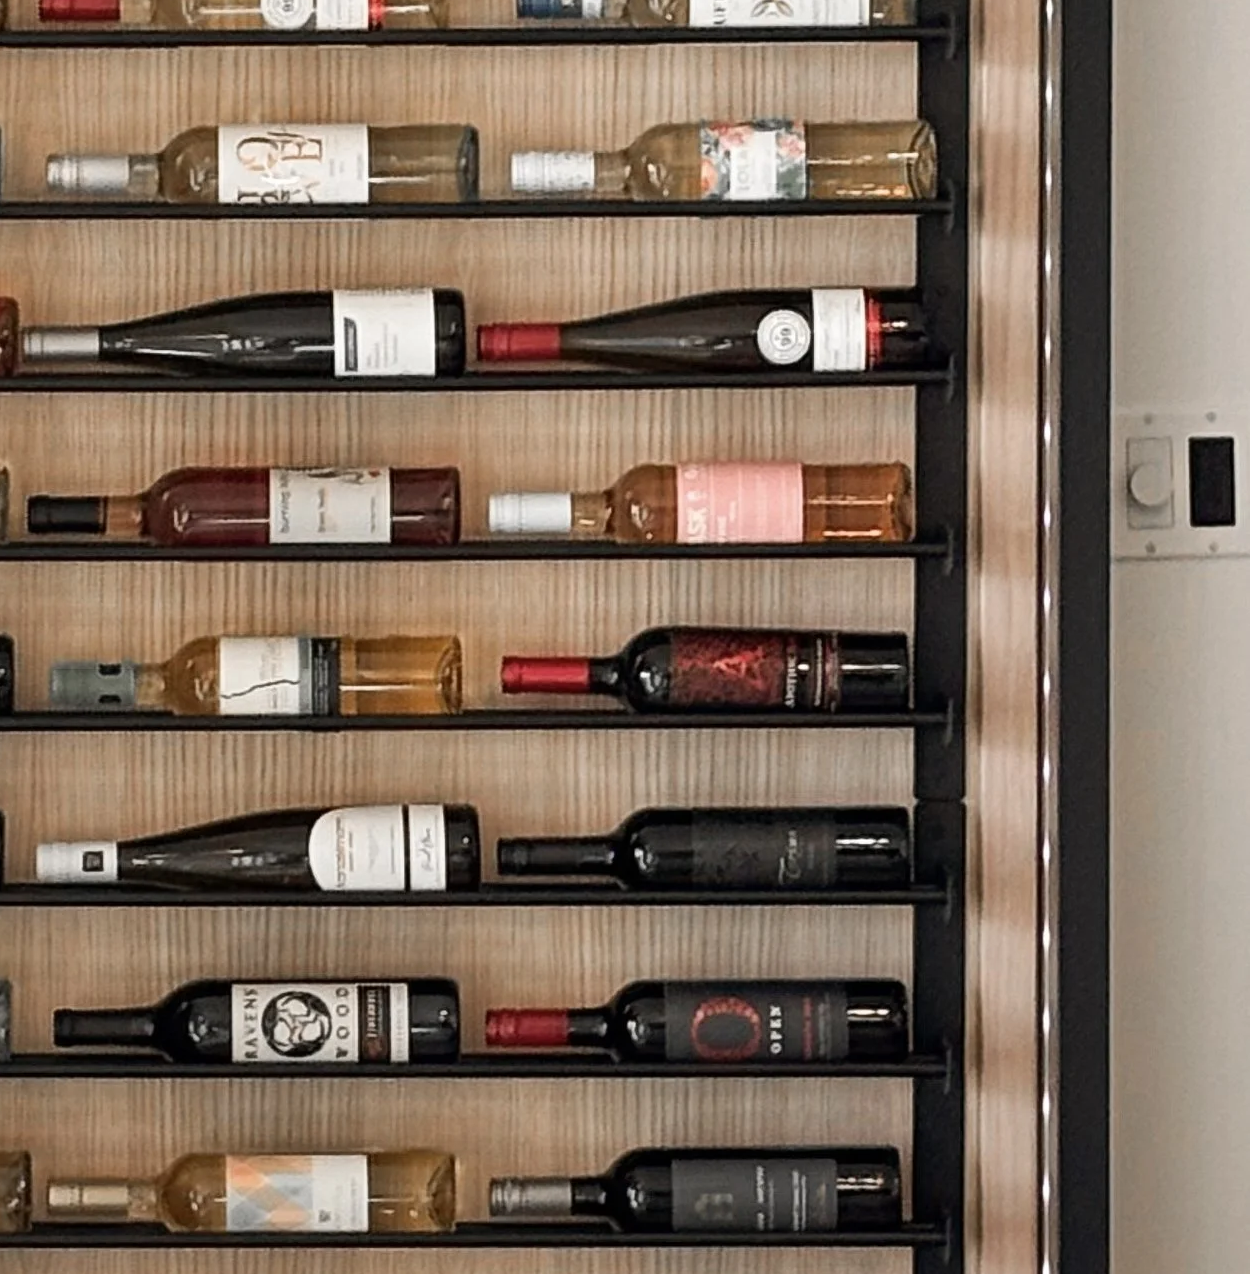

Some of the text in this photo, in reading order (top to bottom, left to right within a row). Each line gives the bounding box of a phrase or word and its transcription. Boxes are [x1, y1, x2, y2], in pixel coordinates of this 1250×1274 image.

[244, 988, 259, 1060] RAVENS
[335, 986, 350, 1060] WOOD
[769, 1004, 783, 1055] OPEN
